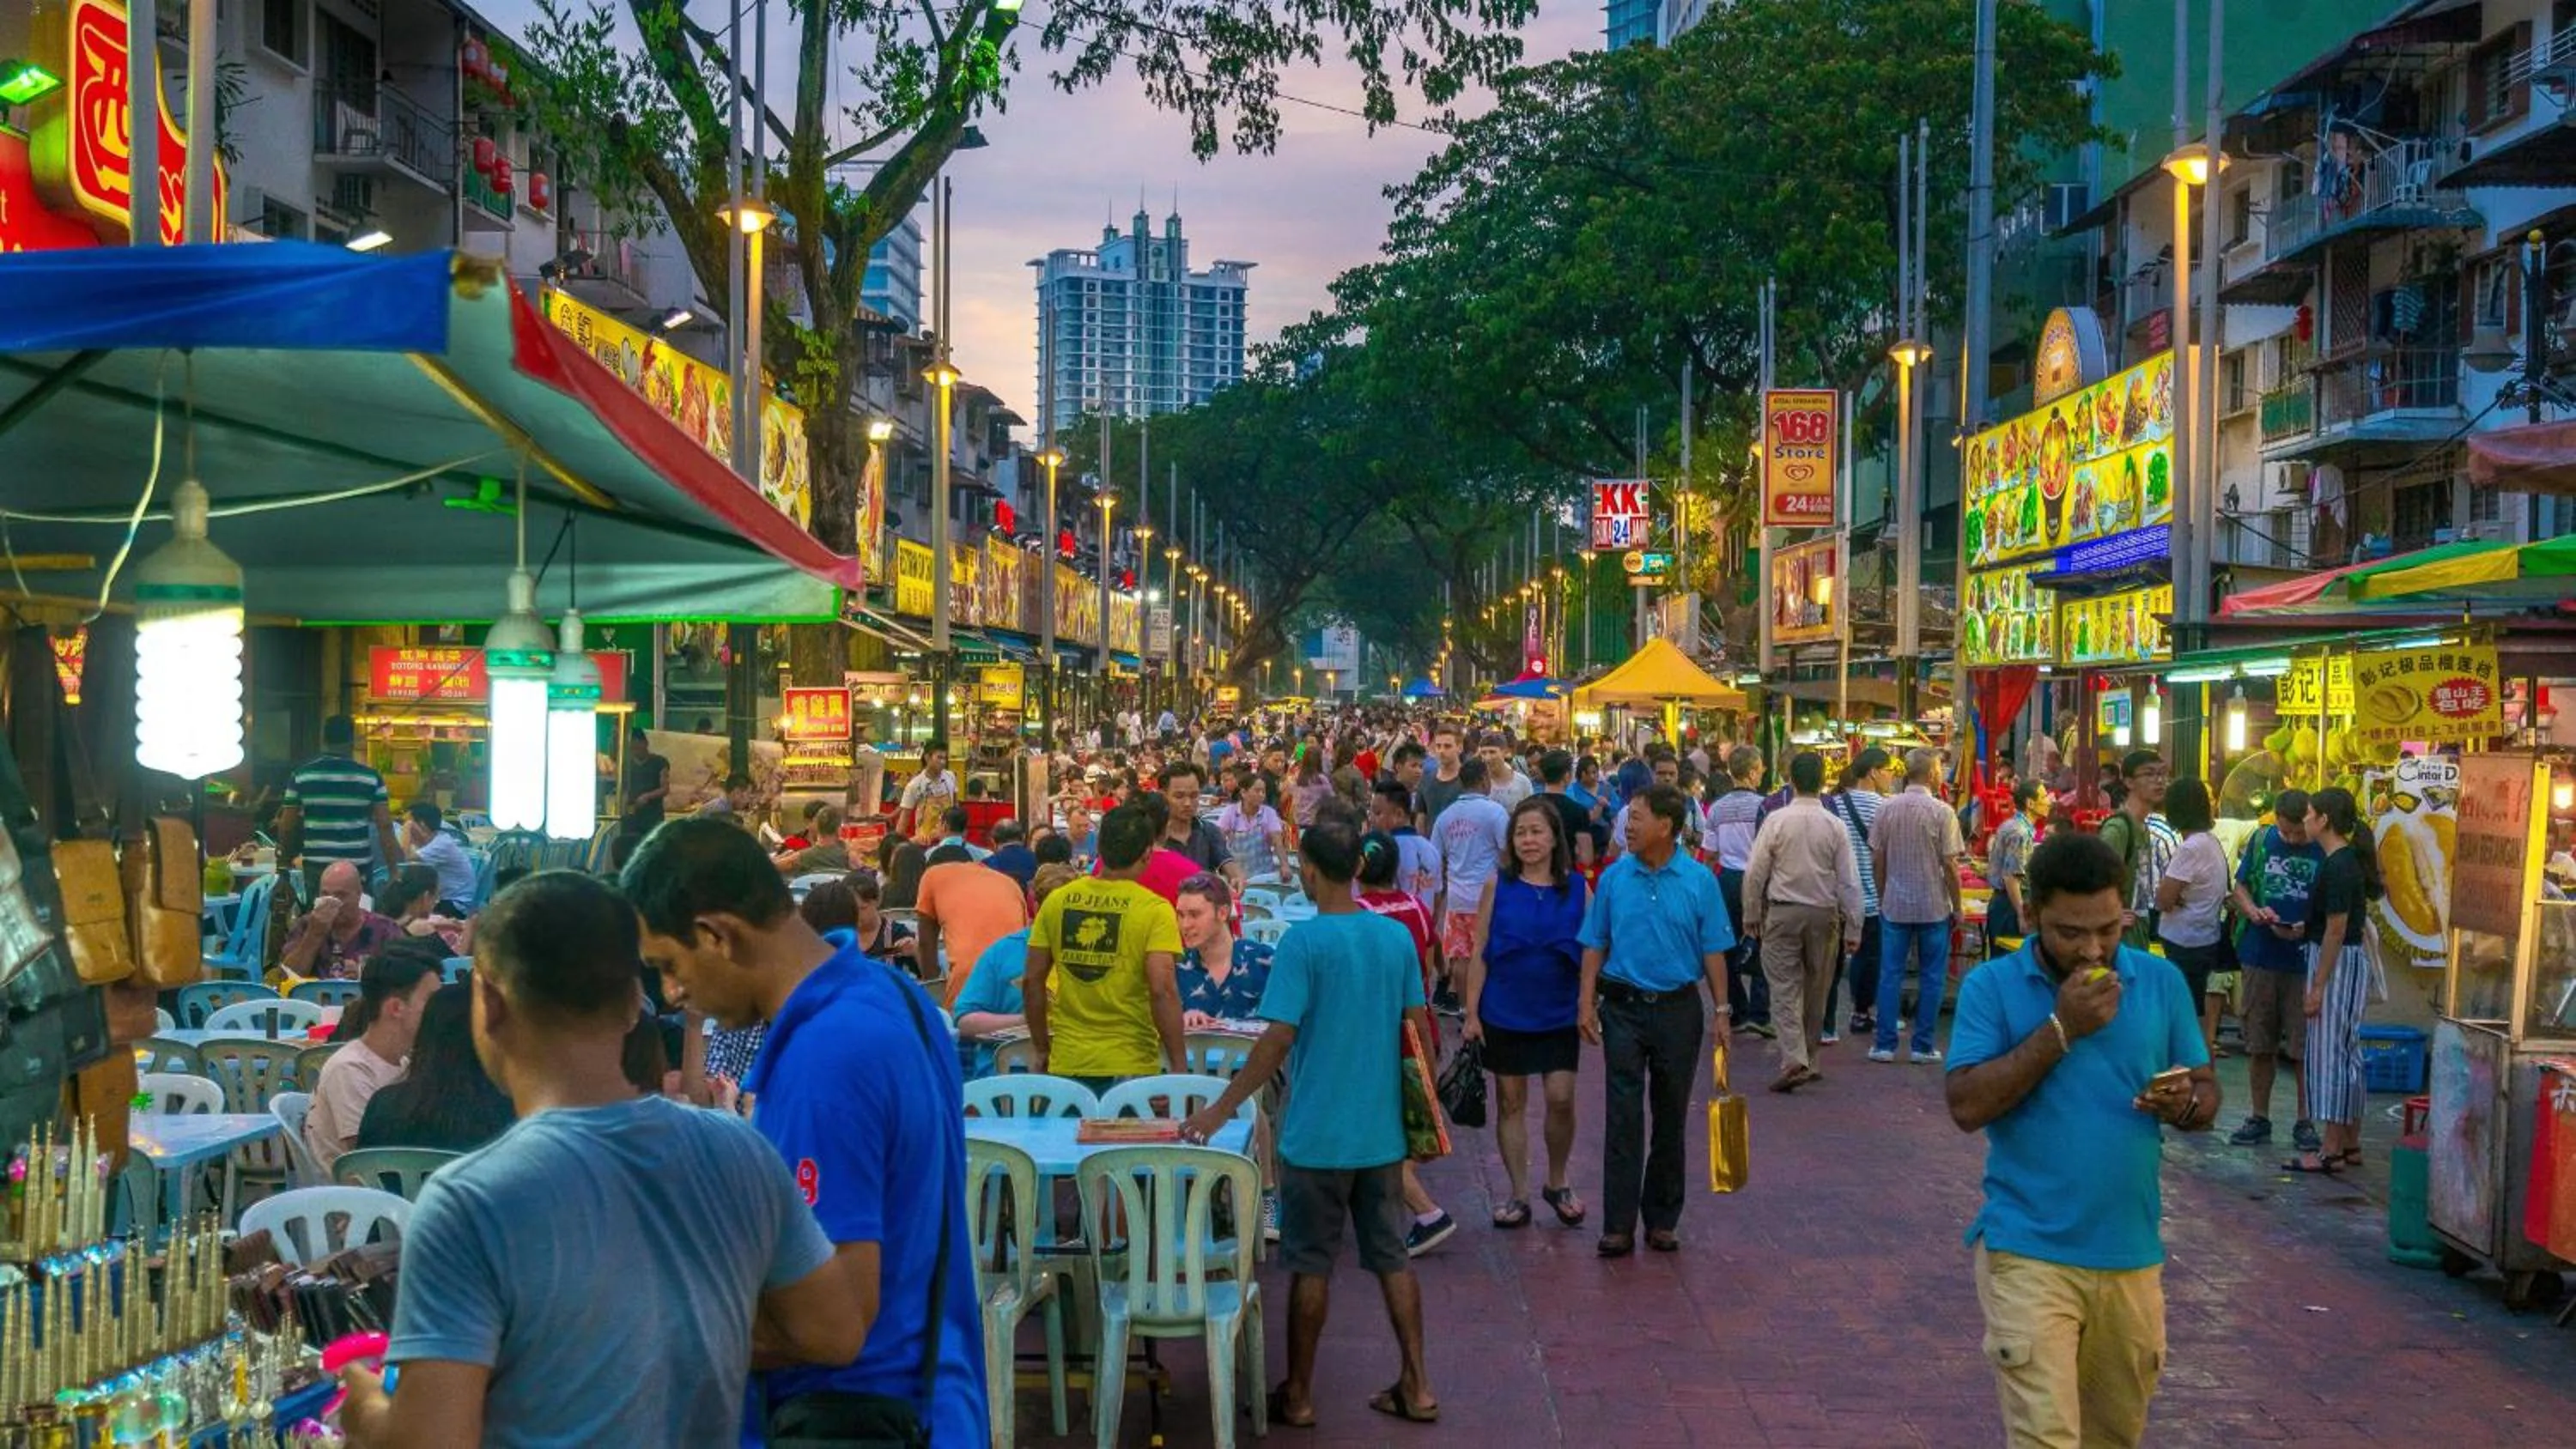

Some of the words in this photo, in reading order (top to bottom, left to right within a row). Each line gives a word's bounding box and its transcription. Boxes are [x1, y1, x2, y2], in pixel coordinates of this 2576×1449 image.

[1772, 410, 1830, 444] 168
[1775, 446, 1826, 458] Store
[1601, 483, 1641, 513] KK
[1786, 495, 1807, 512] 24
[1614, 519, 1628, 543] 24
[797, 1157, 818, 1206] 9
